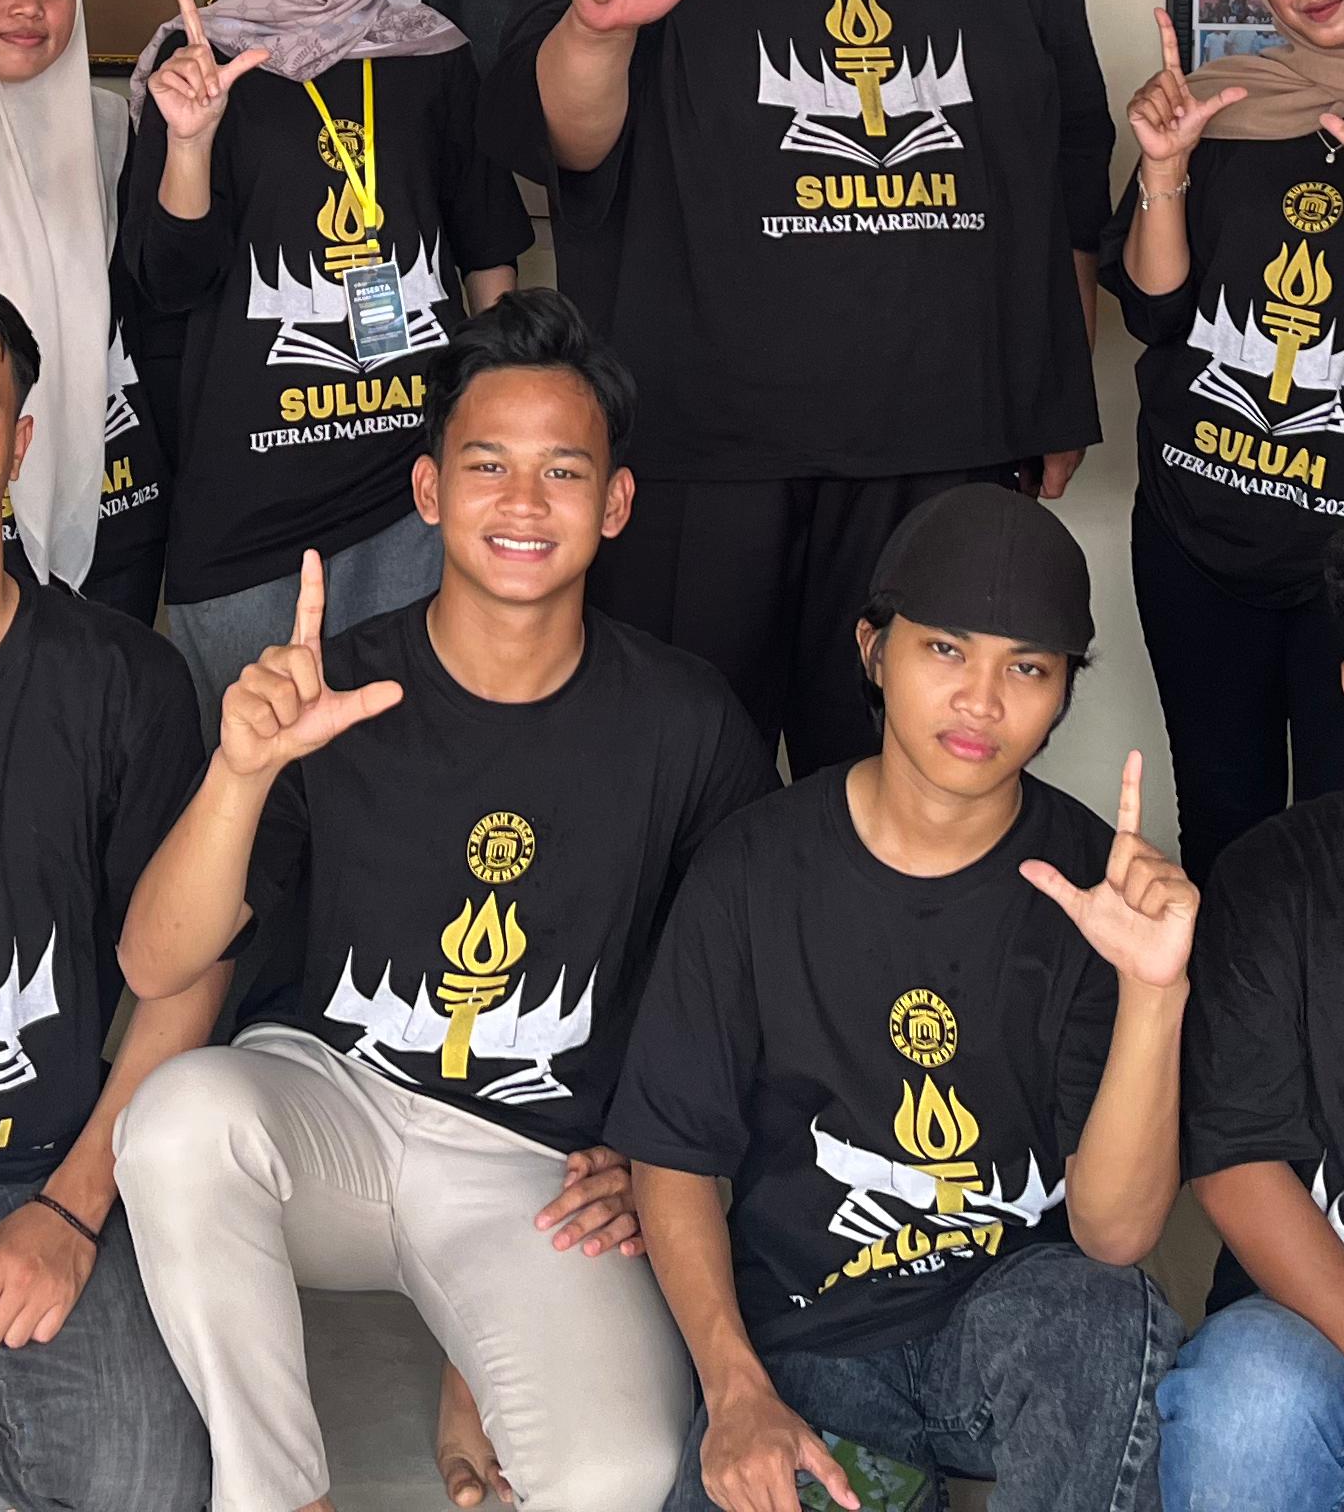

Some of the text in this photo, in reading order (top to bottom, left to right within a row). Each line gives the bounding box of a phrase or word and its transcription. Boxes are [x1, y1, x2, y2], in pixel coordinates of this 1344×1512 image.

[796, 172, 957, 209] SULUAH
[762, 213, 985, 238] LITERASI MARENDA 2025
[250, 424, 331, 452] LITERASI
[1162, 443, 1229, 484] LITERASI
[1227, 468, 1309, 509] MARENA
[132, 483, 159, 507] 2025
[469, 813, 534, 845] RUMAH BACA
[469, 854, 529, 881] MARENDA
[892, 989, 927, 1019] RUMAH
